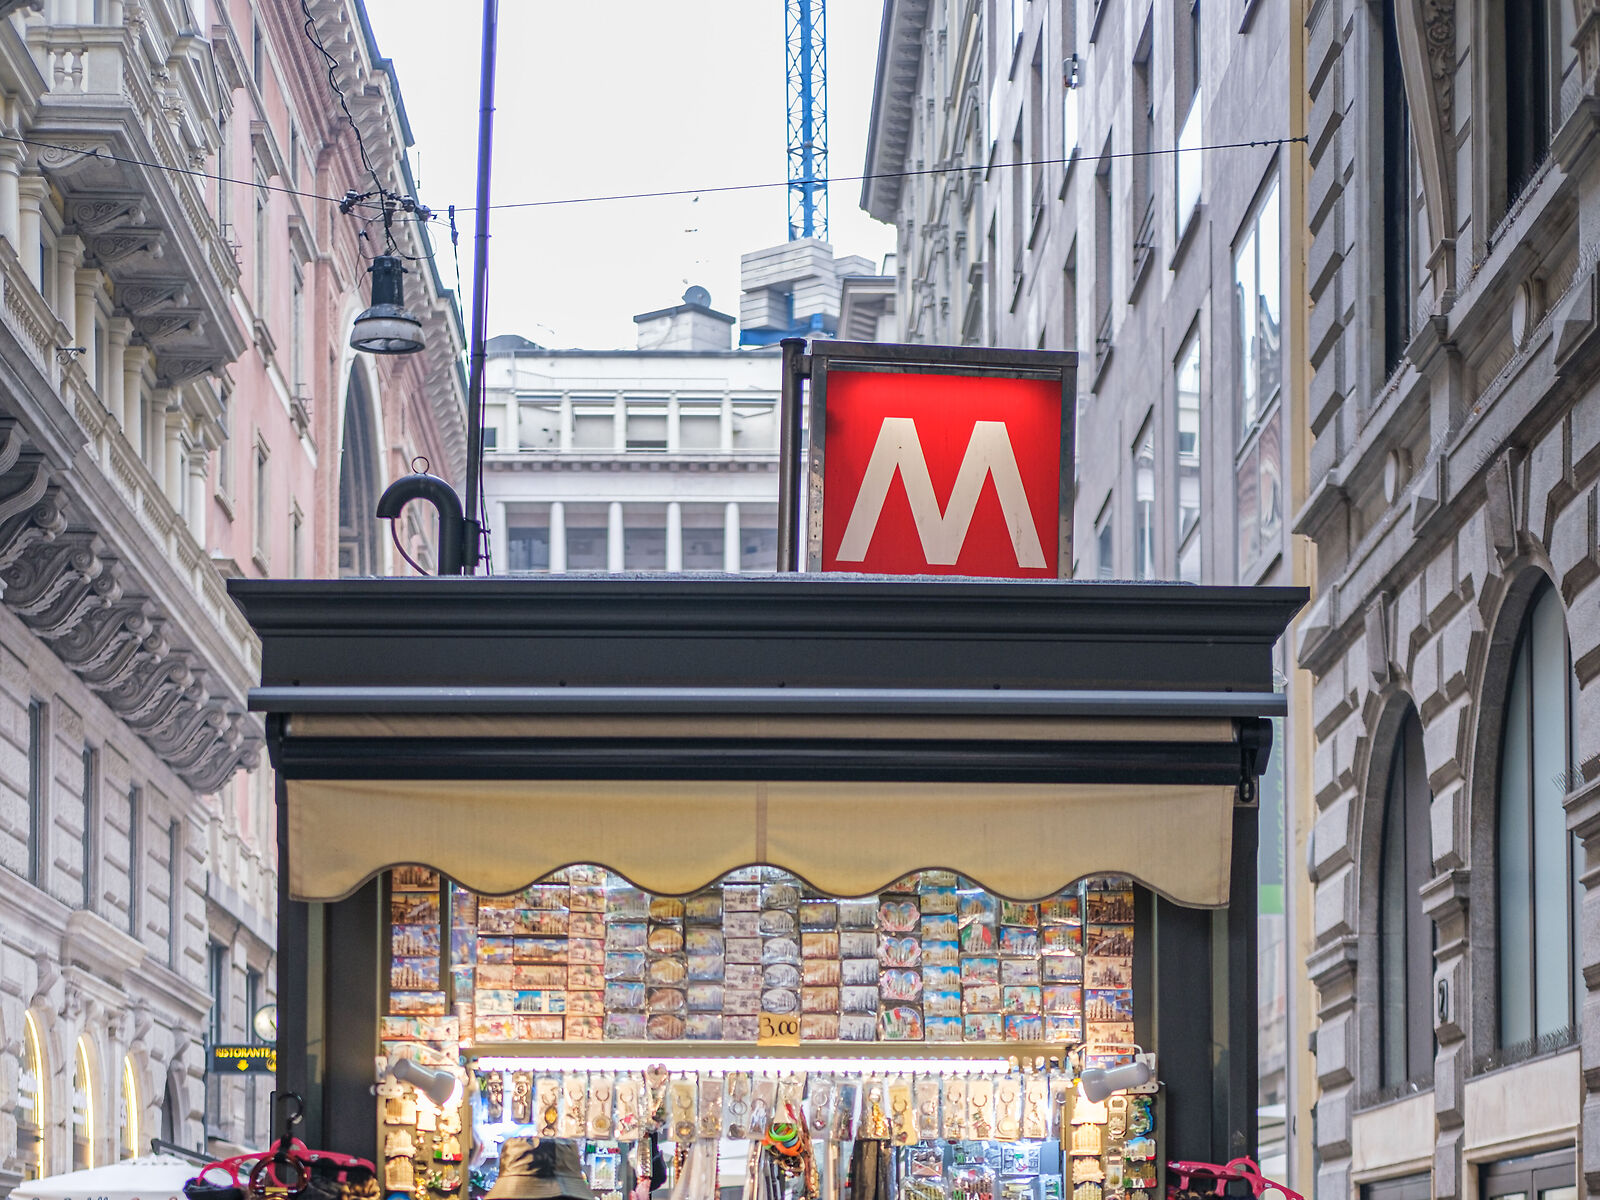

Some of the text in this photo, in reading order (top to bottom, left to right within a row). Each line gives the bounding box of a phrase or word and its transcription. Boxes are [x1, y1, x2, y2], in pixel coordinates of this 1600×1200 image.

[836, 417, 1048, 568] M
[761, 1017, 798, 1038] 3.00
[216, 1047, 271, 1058] RISTORANTE
